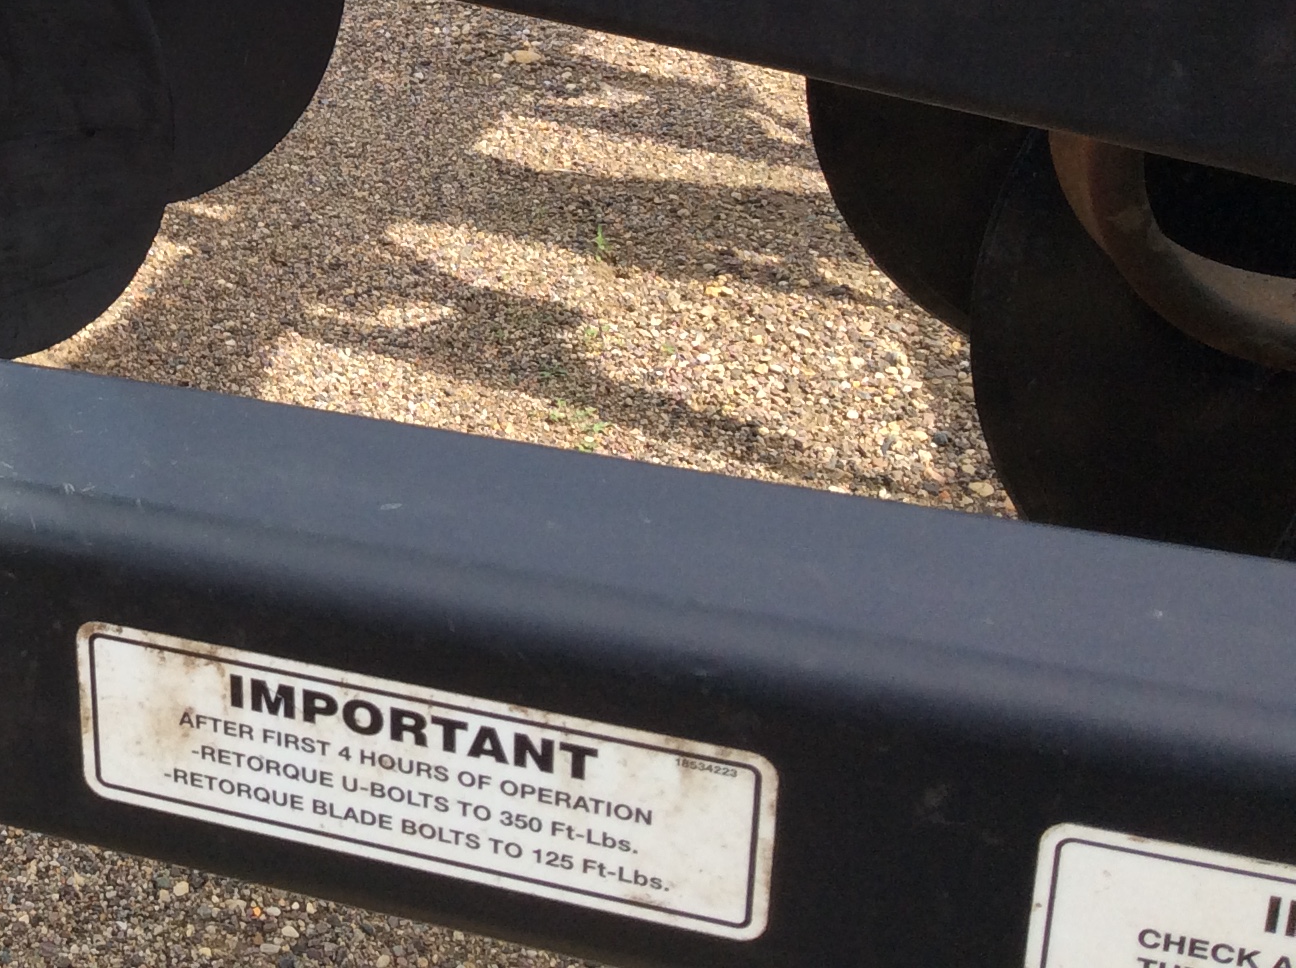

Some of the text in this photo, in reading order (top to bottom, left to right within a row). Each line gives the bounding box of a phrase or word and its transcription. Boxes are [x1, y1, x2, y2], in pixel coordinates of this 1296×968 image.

[179, 711, 652, 825] AFTER FIRST 4 HOURS OF OPERATION
[229, 673, 599, 780] IMPORTANT
[164, 768, 670, 892] -RETORQUE BLADE BOLTS TO 125 Ft-Lbs.
[192, 745, 639, 854] -RETORQUE U-BOLTS TO 350 Ft-Lbs.
[1138, 928, 1261, 968] CHECK
